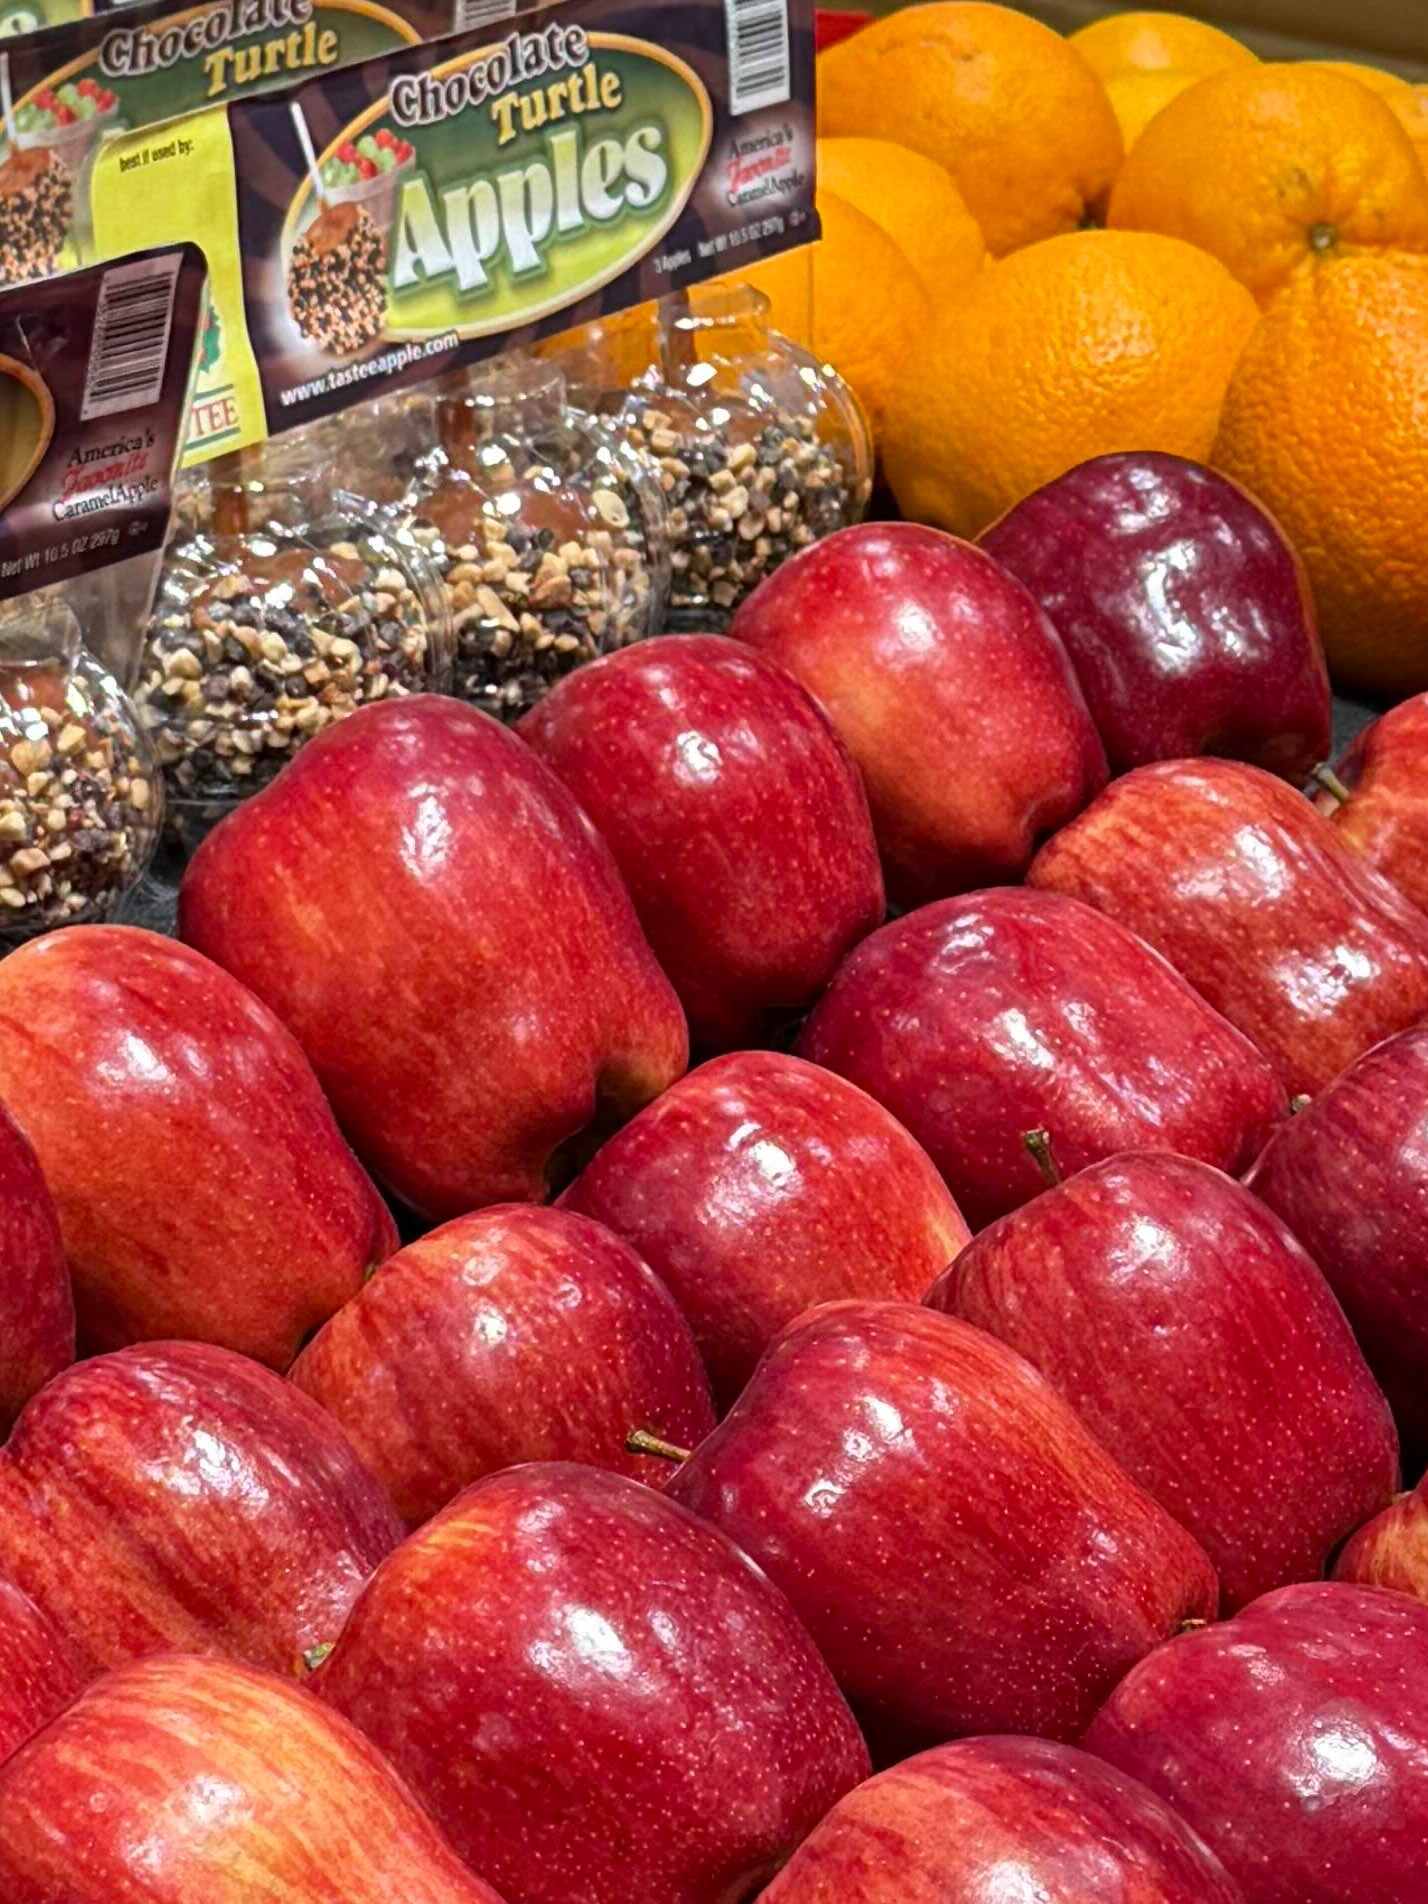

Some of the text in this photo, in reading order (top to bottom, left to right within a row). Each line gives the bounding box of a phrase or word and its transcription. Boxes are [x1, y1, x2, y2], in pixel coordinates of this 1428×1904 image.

[203, 20, 339, 97] Turtle
[391, 23, 590, 127] Chocolate
[491, 62, 623, 146] Turtle
[119, 154, 141, 173] best
[152, 143, 176, 162] used
[393, 126, 668, 292] Apples
[280, 332, 459, 407] www.tasteeapple.com
[67, 427, 155, 467] America's
[191, 396, 240, 436] TEE
[1, 560, 21, 578] Net
